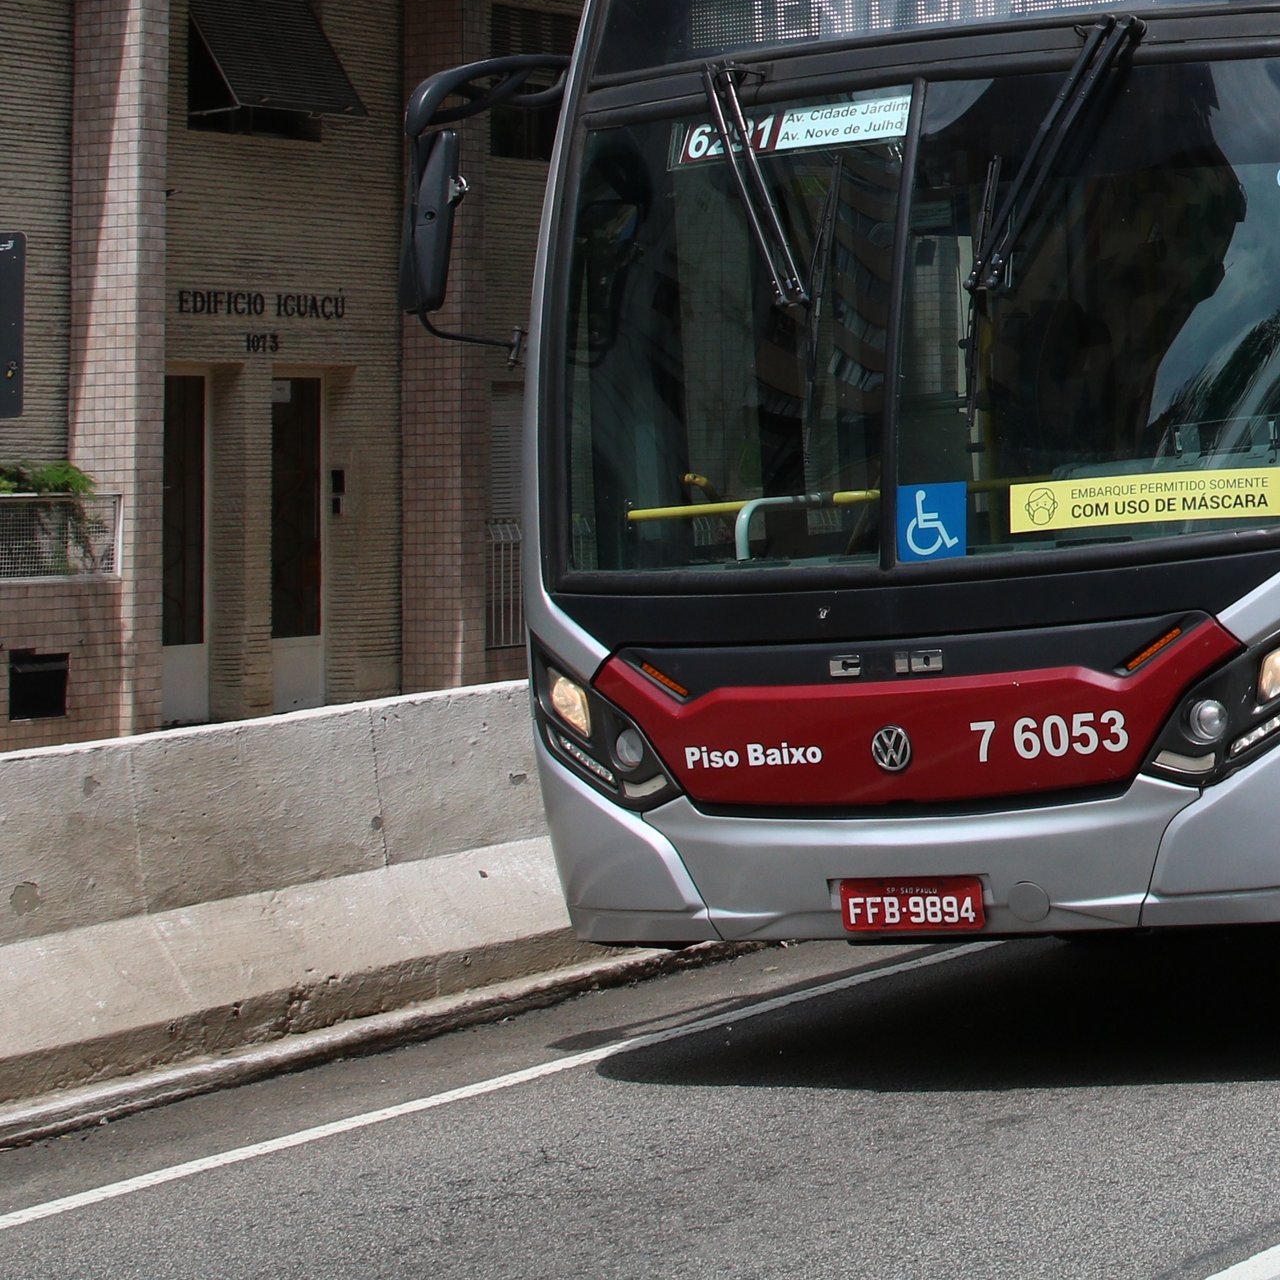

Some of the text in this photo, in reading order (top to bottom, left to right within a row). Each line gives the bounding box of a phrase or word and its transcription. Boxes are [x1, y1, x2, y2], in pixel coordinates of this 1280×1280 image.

[785, 113, 806, 124] Av.
[809, 106, 858, 121] Cidade
[779, 118, 904, 143] Av. Nove de Julho
[178, 290, 265, 316] EDIFICIO
[246, 333, 279, 353] 1073
[1070, 476, 1269, 500] EMBARQUE PERMITIDO SOMENTE
[1070, 492, 1269, 519] COM USO DE MÁSCARA
[970, 710, 1130, 763] 7 6053
[684, 741, 823, 770] Piso Baixo
